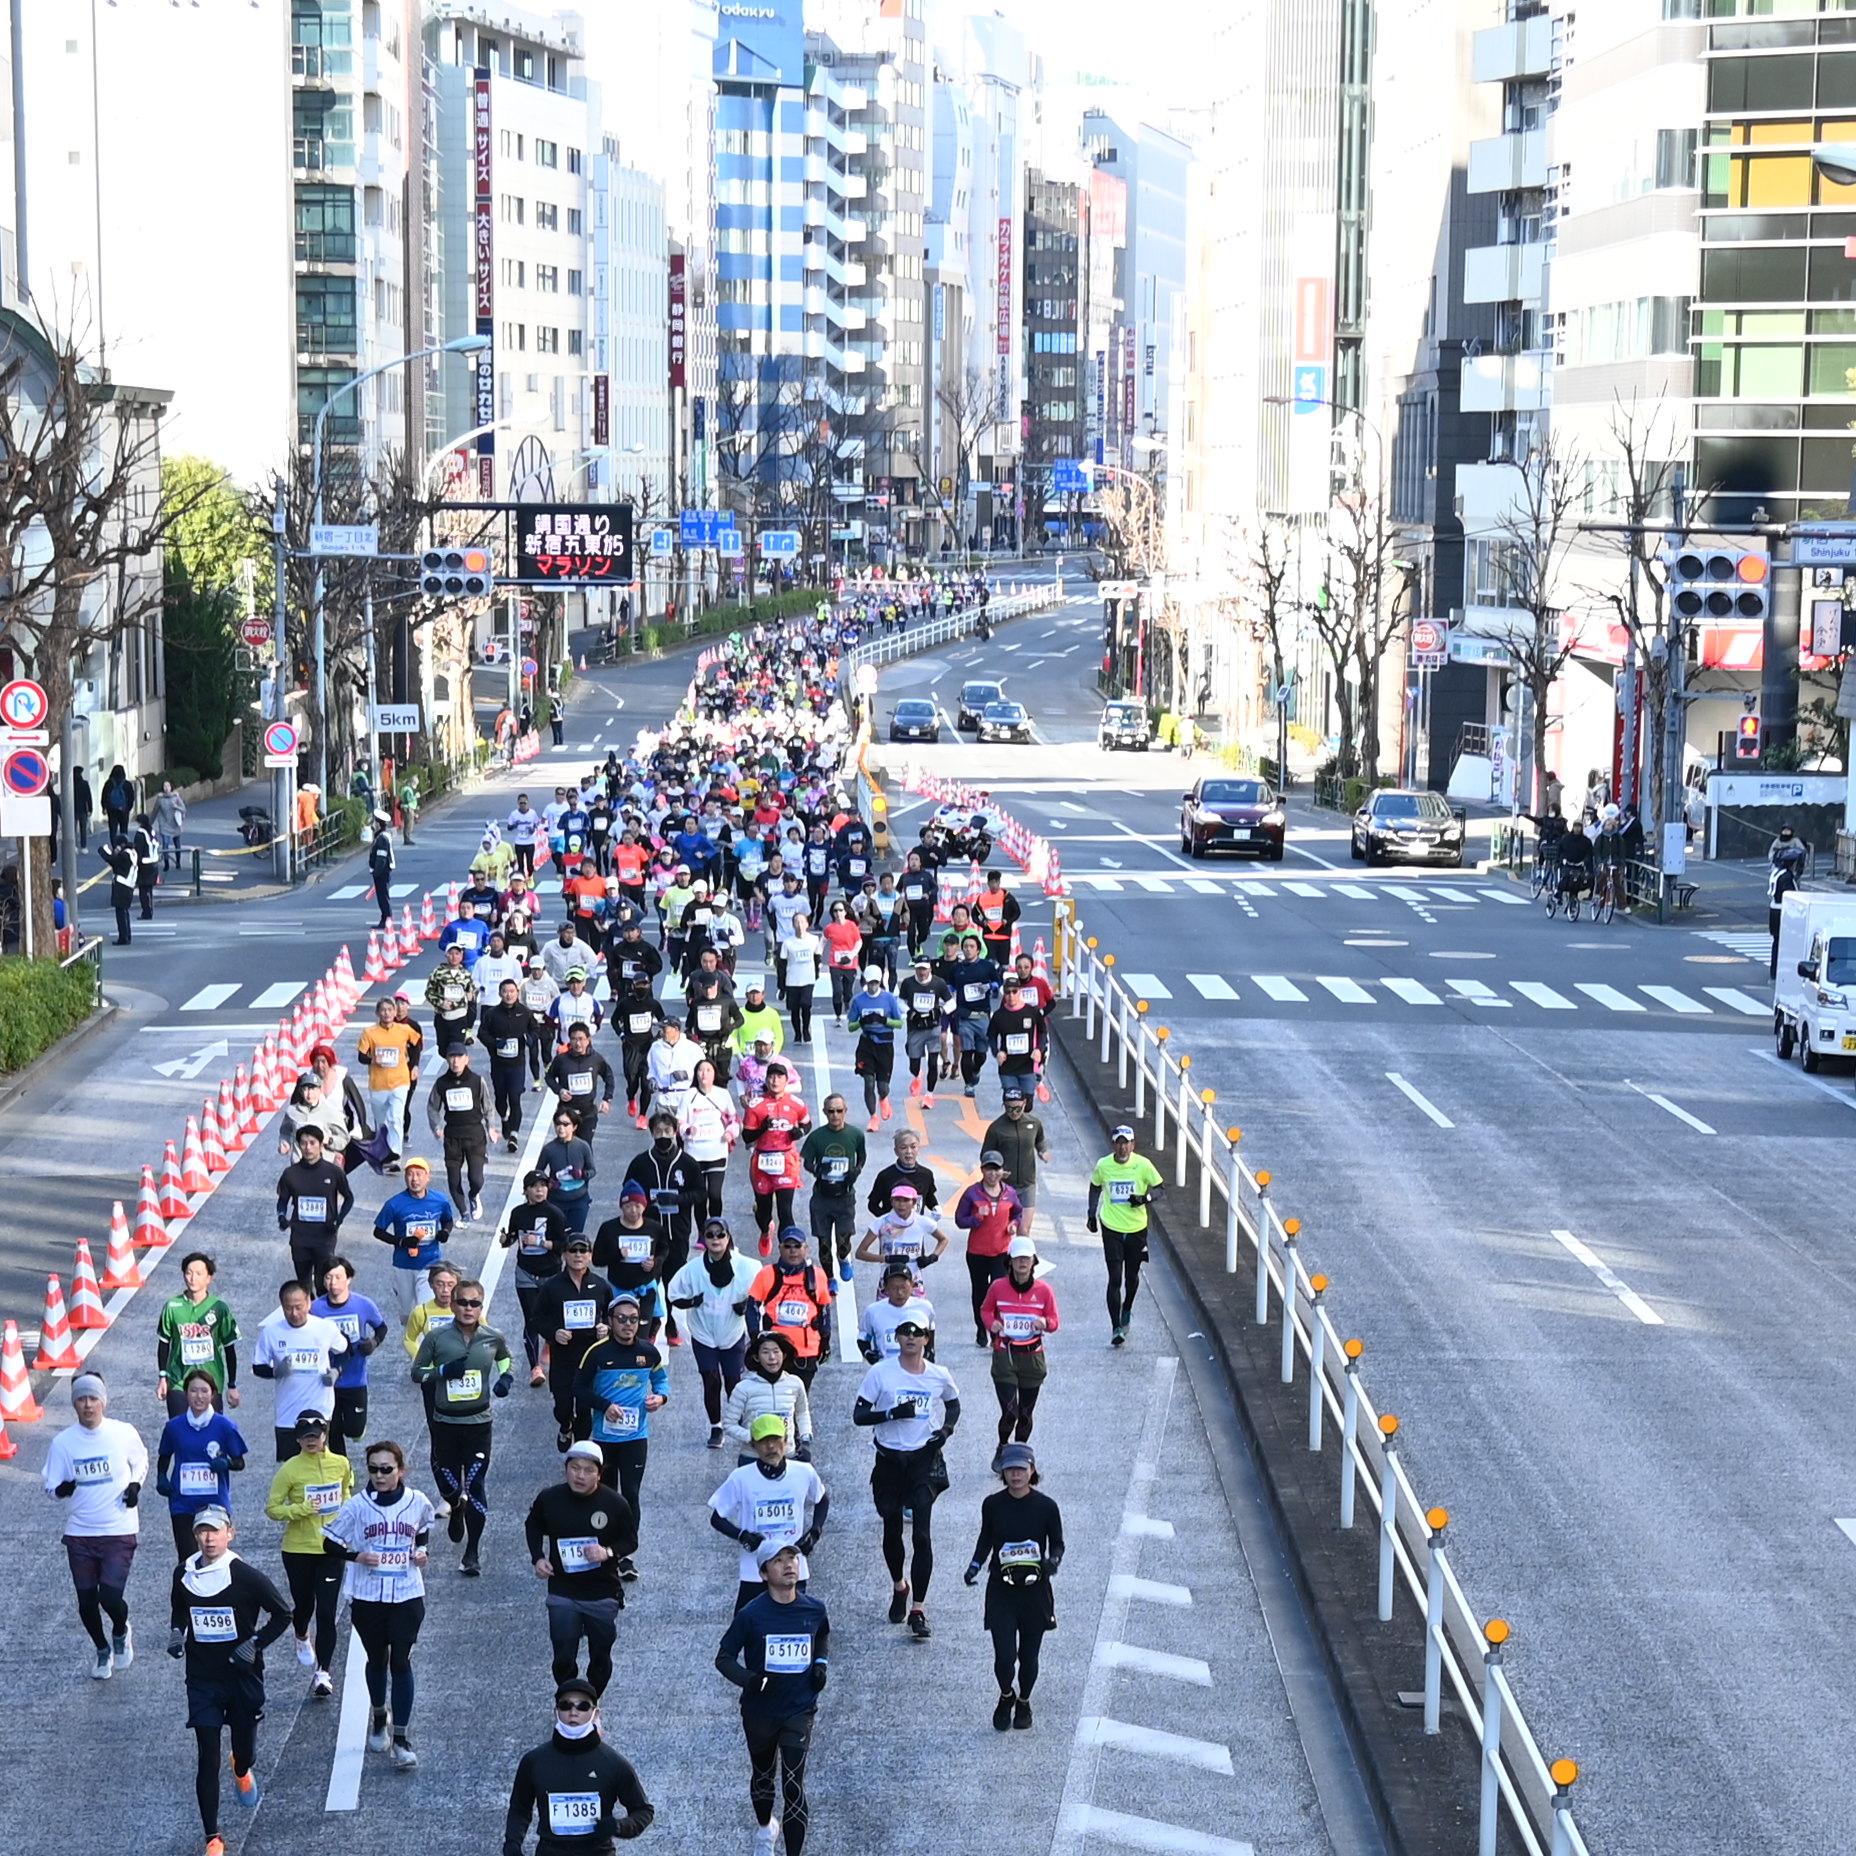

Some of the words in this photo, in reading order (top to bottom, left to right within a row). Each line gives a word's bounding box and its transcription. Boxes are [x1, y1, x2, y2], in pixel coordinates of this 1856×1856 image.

[721, 4, 775, 18] odakyu
[672, 303, 684, 365] 静岡銀行
[535, 514, 610, 535] 靖国通り
[525, 534, 624, 556] 新宿五東から
[1810, 546, 1849, 558] Shinjuku
[537, 556, 612, 576] マラソン
[381, 713, 417, 726] 5km
[767, 1504, 794, 1518] 5015
[569, 1546, 583, 1558] 15
[381, 1553, 408, 1566] 8203
[204, 1615, 232, 1629] 4596
[780, 1643, 809, 1658] 5170
[564, 1802, 598, 1819] 1385
